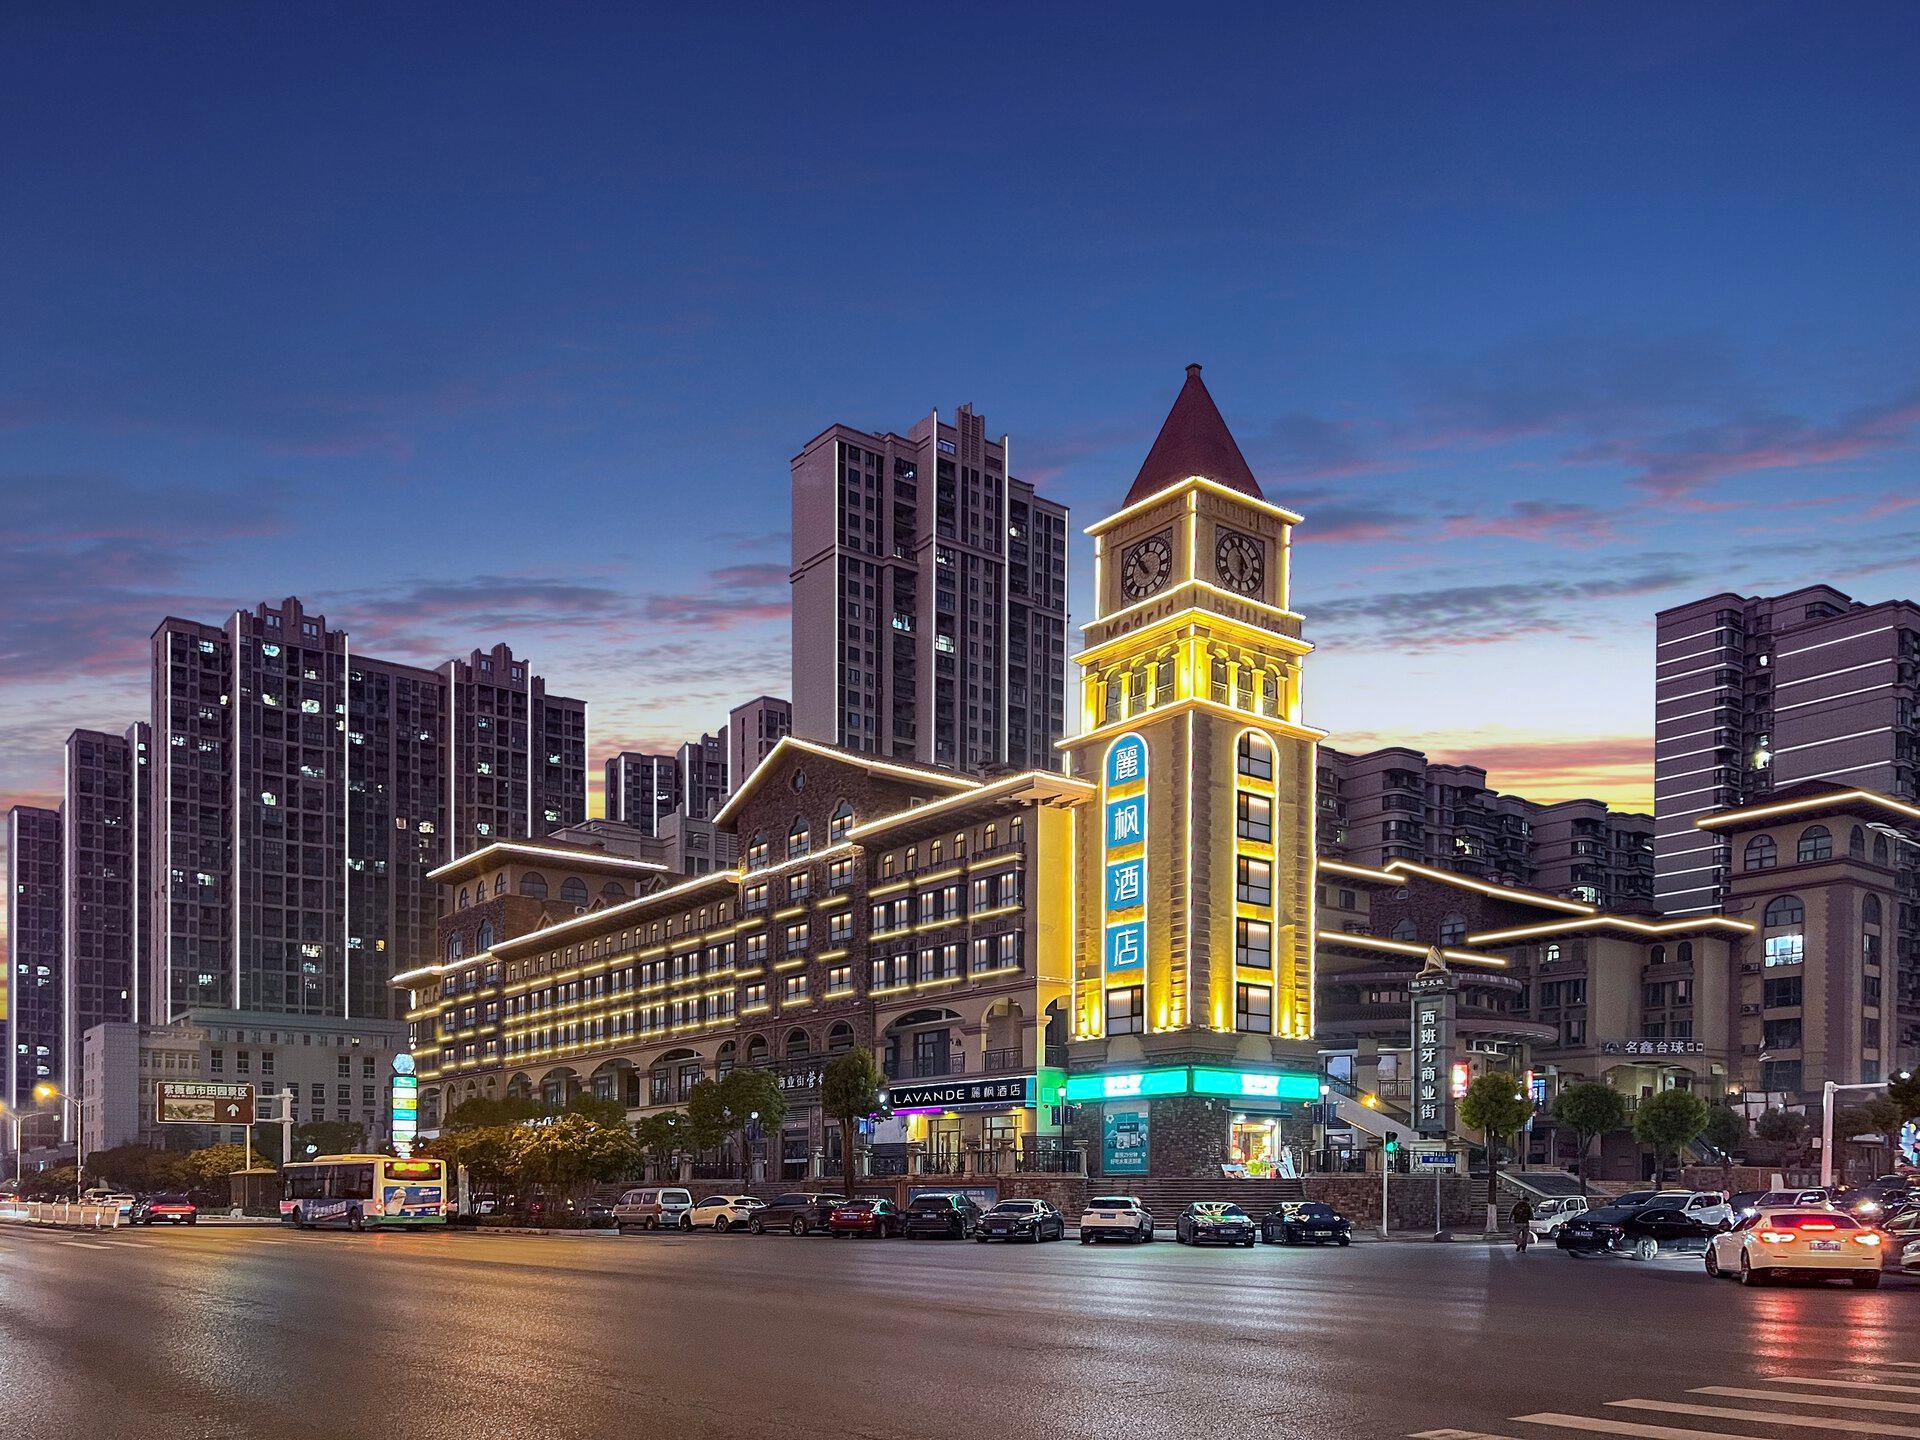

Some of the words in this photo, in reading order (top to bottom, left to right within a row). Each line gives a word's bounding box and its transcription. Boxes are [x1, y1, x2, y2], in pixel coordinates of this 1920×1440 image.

[1105, 598, 1174, 639] Madrid
[1421, 1010, 1437, 1119] 西班牙商业街
[893, 1089, 965, 1104] LAVANDE
